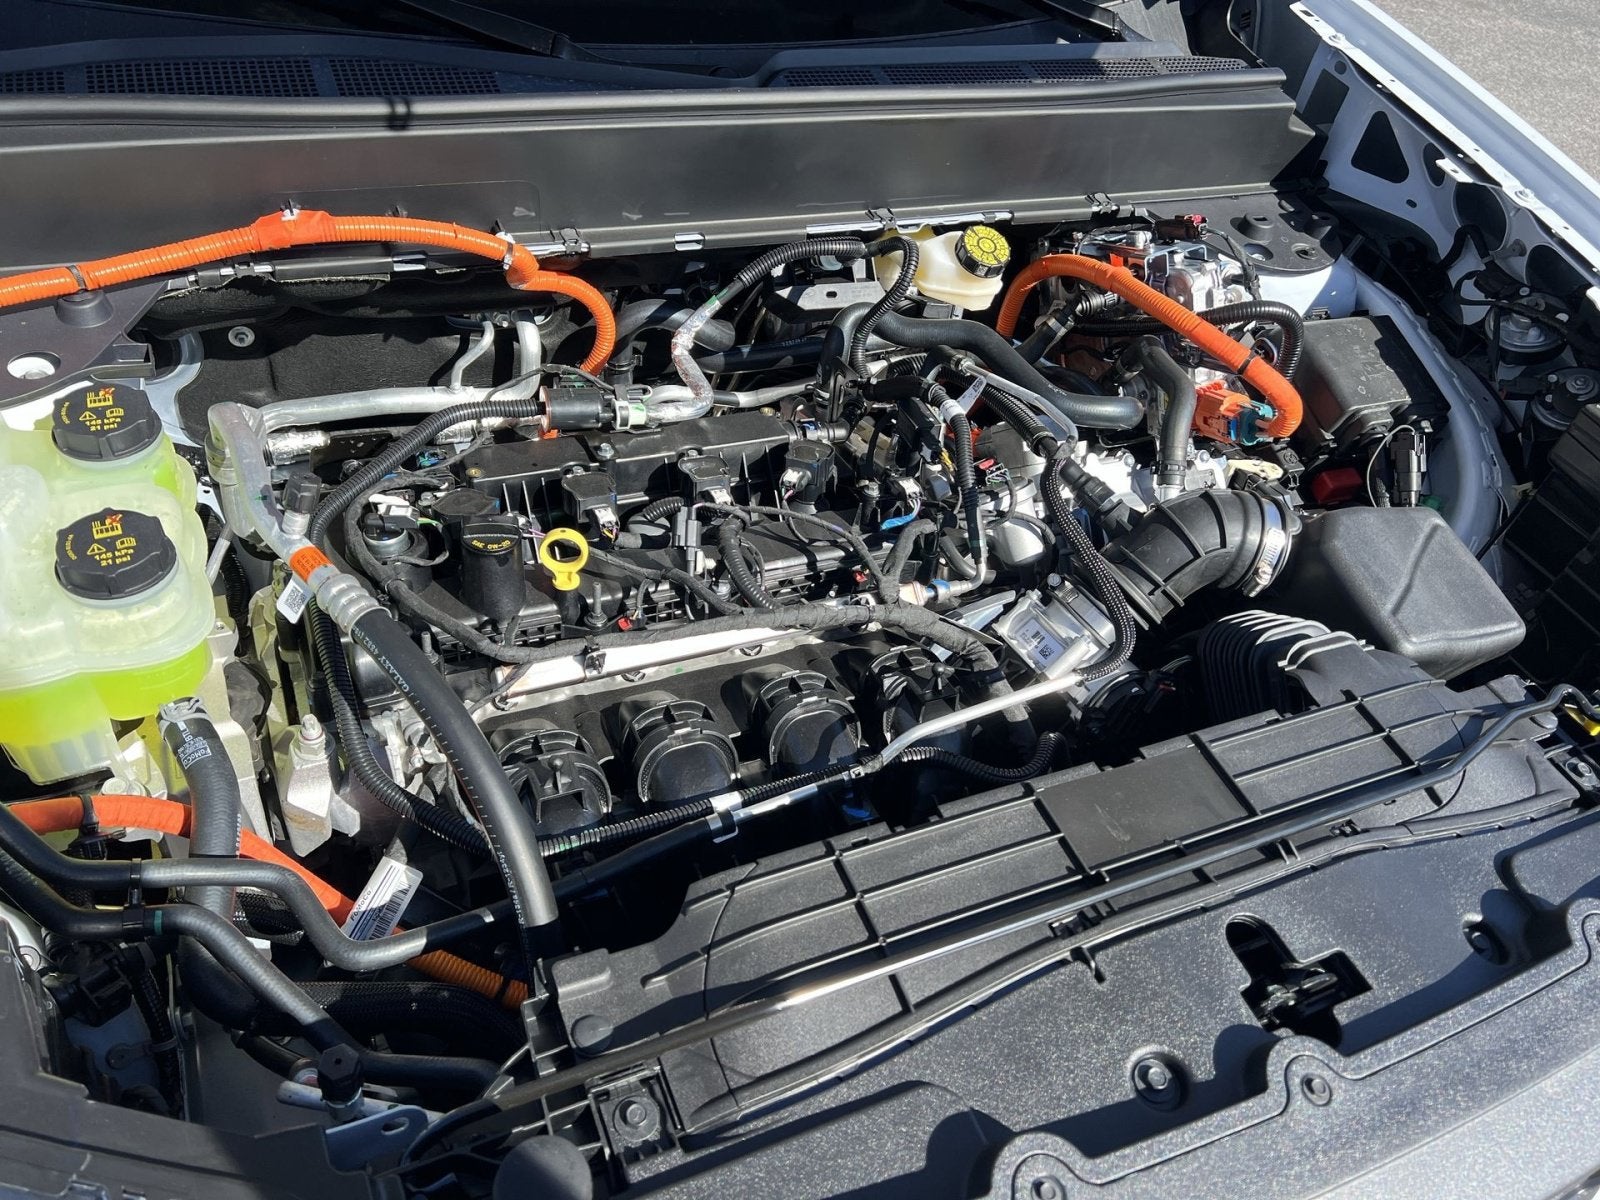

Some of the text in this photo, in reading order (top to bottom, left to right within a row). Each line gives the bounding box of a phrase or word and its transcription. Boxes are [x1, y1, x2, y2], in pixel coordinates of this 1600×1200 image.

[104, 422, 117, 430] psi
[471, 540, 511, 550] SAE 0W-20
[94, 549, 134, 561] 145 kPa
[100, 555, 130, 567] 21 psi
[378, 655, 410, 692] GALAXY
[183, 746, 211, 765] FoMoCo
[350, 889, 373, 922] FoMoCo
